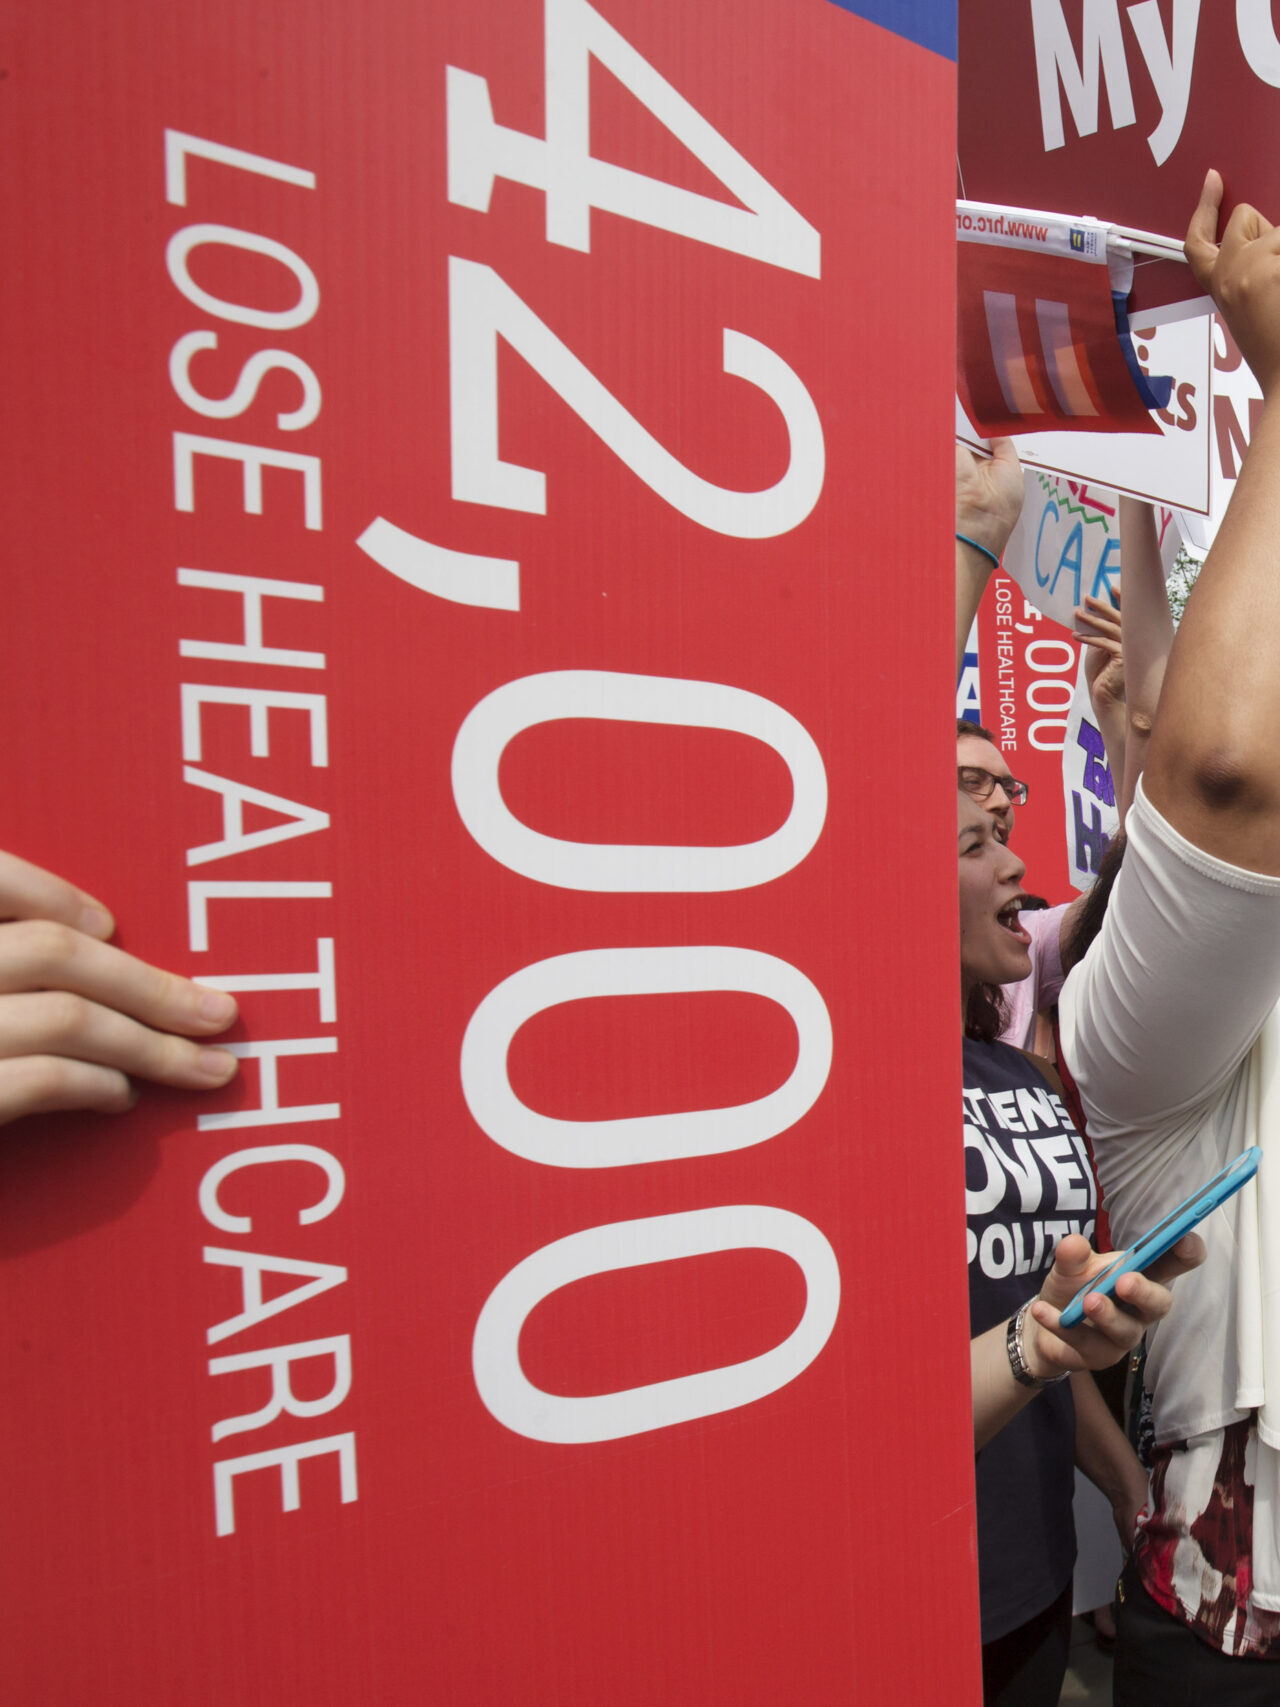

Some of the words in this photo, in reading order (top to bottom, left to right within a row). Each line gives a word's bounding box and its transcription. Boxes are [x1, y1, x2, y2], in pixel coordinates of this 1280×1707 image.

[1031, 0, 1200, 168] My
[165, 127, 323, 531] LOSE
[355, 0, 841, 1445] 42,000
[994, 578, 1012, 626] LOSE
[996, 631, 1017, 752] HEALTHCARE
[177, 566, 359, 1538] HEALTHCARE
